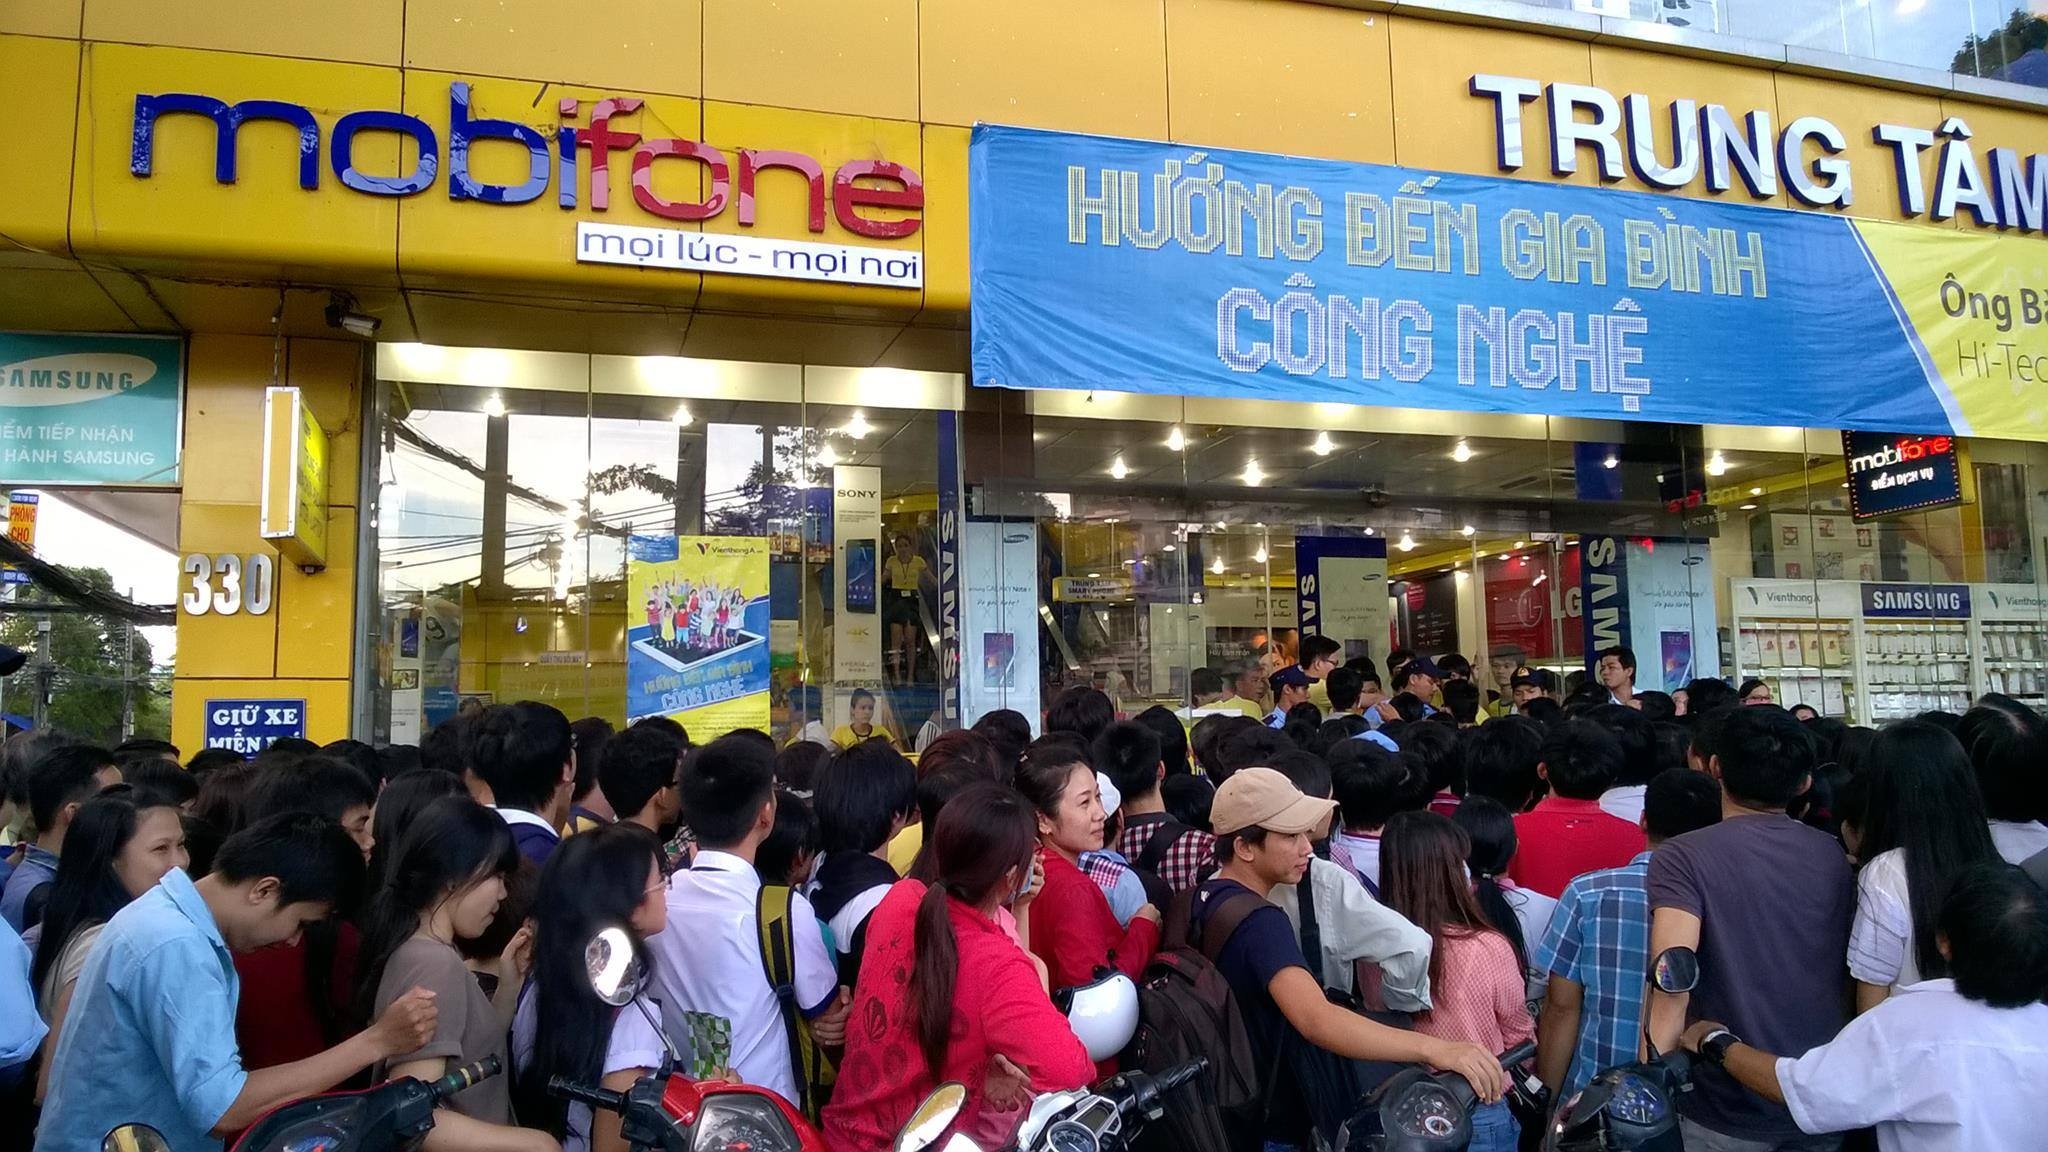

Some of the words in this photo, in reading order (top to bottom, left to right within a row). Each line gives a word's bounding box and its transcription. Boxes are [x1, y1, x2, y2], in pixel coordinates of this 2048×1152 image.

[131, 81, 925, 240] mobifone
[1468, 73, 1853, 209] TRUNG
[1871, 116, 2048, 234] TÂM
[1067, 151, 1323, 262] HƯỚNG
[1345, 175, 1480, 276] ĐẾN
[1500, 208, 1607, 286] GIA
[1623, 206, 1768, 298] ĐÌNH
[583, 232, 664, 262] mọi
[678, 235, 738, 265] lúc
[772, 248, 847, 277] mọi
[860, 255, 918, 280] nơi
[1939, 271, 2013, 332] Ông
[1217, 271, 1433, 383] CÔNG
[1456, 297, 1651, 412] NGHỆ
[38, 421, 75, 442] TIẾP
[80, 425, 134, 445] NHẬN
[4, 444, 57, 465] HÀNH
[63, 450, 156, 466] SAMSUNG
[1851, 436, 1950, 474] mobifone
[837, 489, 877, 499] SONY
[10, 504, 36, 523] PHÒNG
[183, 553, 272, 616] 330
[1873, 590, 1960, 611] SAMSUNG
[1256, 597, 1289, 609] htc
[211, 704, 261, 726] GIỮ
[263, 708, 299, 726] XE
[208, 727, 262, 754] MIỄN
